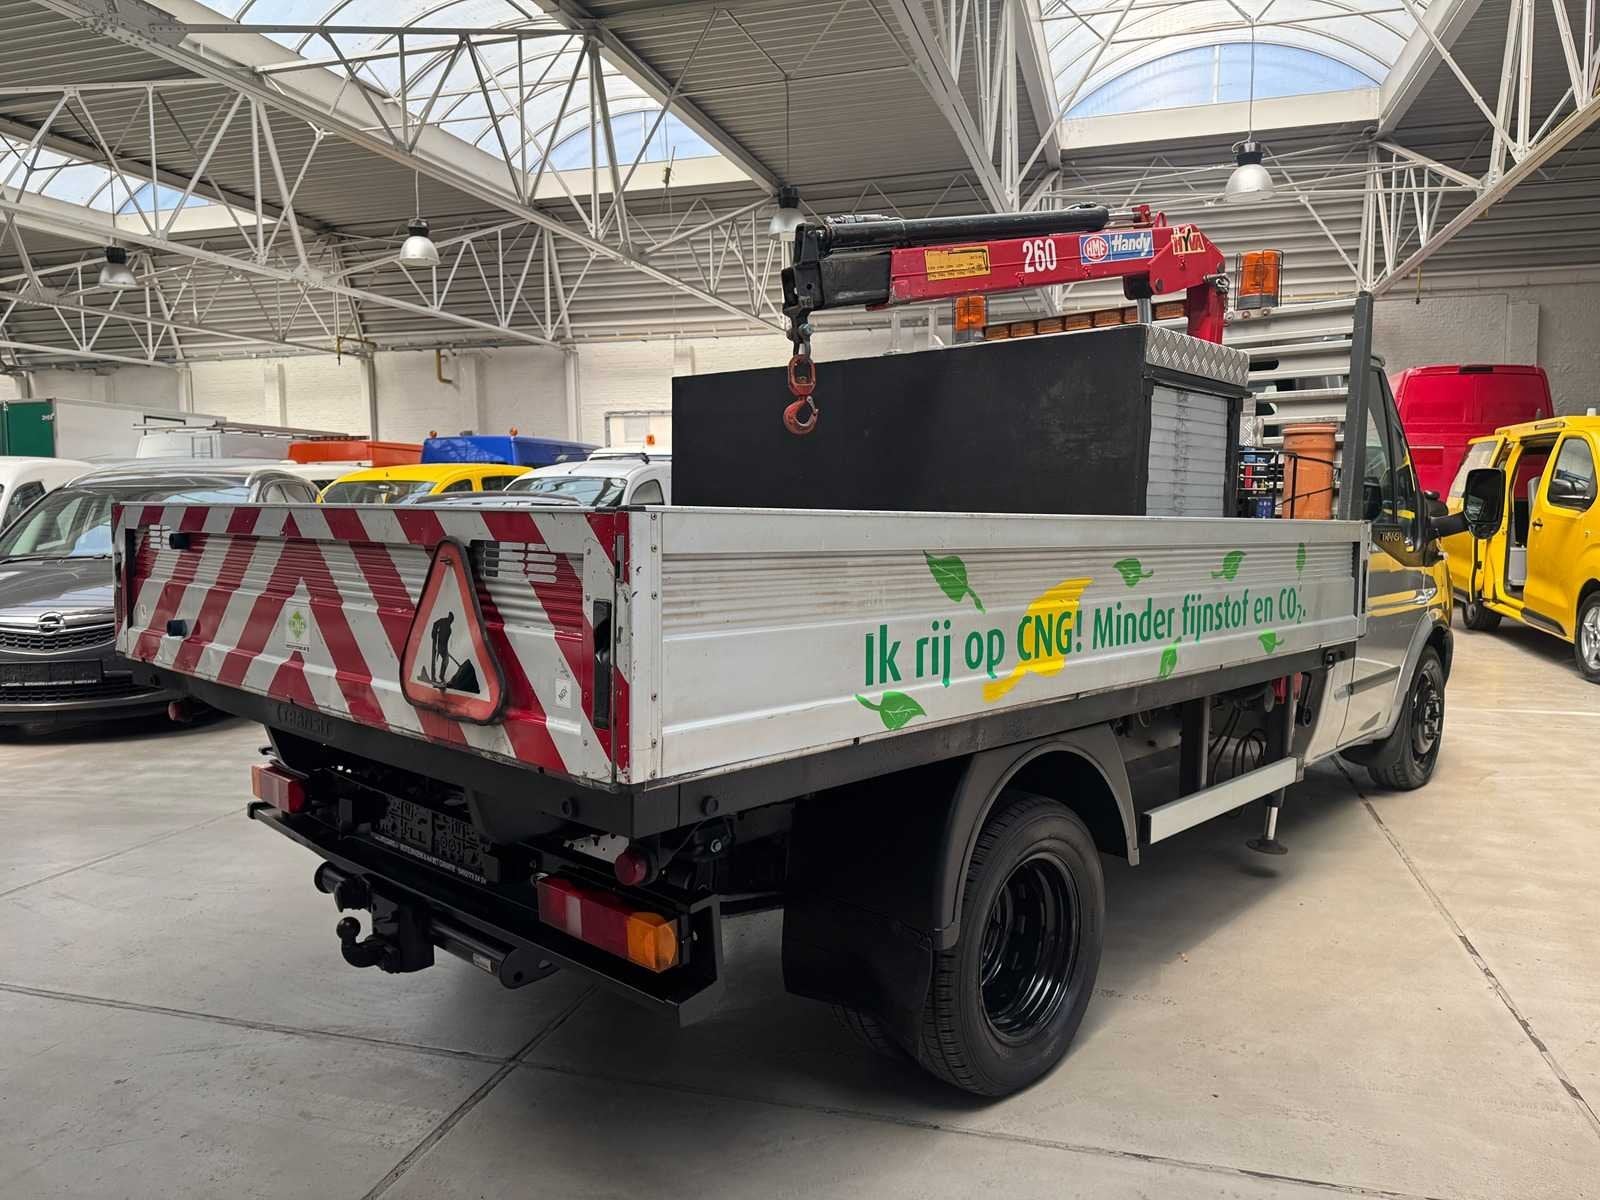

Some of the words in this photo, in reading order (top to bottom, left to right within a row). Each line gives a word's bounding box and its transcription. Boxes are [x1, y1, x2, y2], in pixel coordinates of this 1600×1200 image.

[1023, 239, 1056, 273] 260
[1112, 233, 1150, 257] Handy
[865, 624, 902, 686] Ik
[916, 619, 951, 688] rij
[964, 628, 1005, 679] op
[1017, 610, 1083, 661] CNG!
[1092, 598, 1176, 650] Minder
[1182, 588, 1249, 644] fijnstof
[1254, 596, 1274, 624] en
